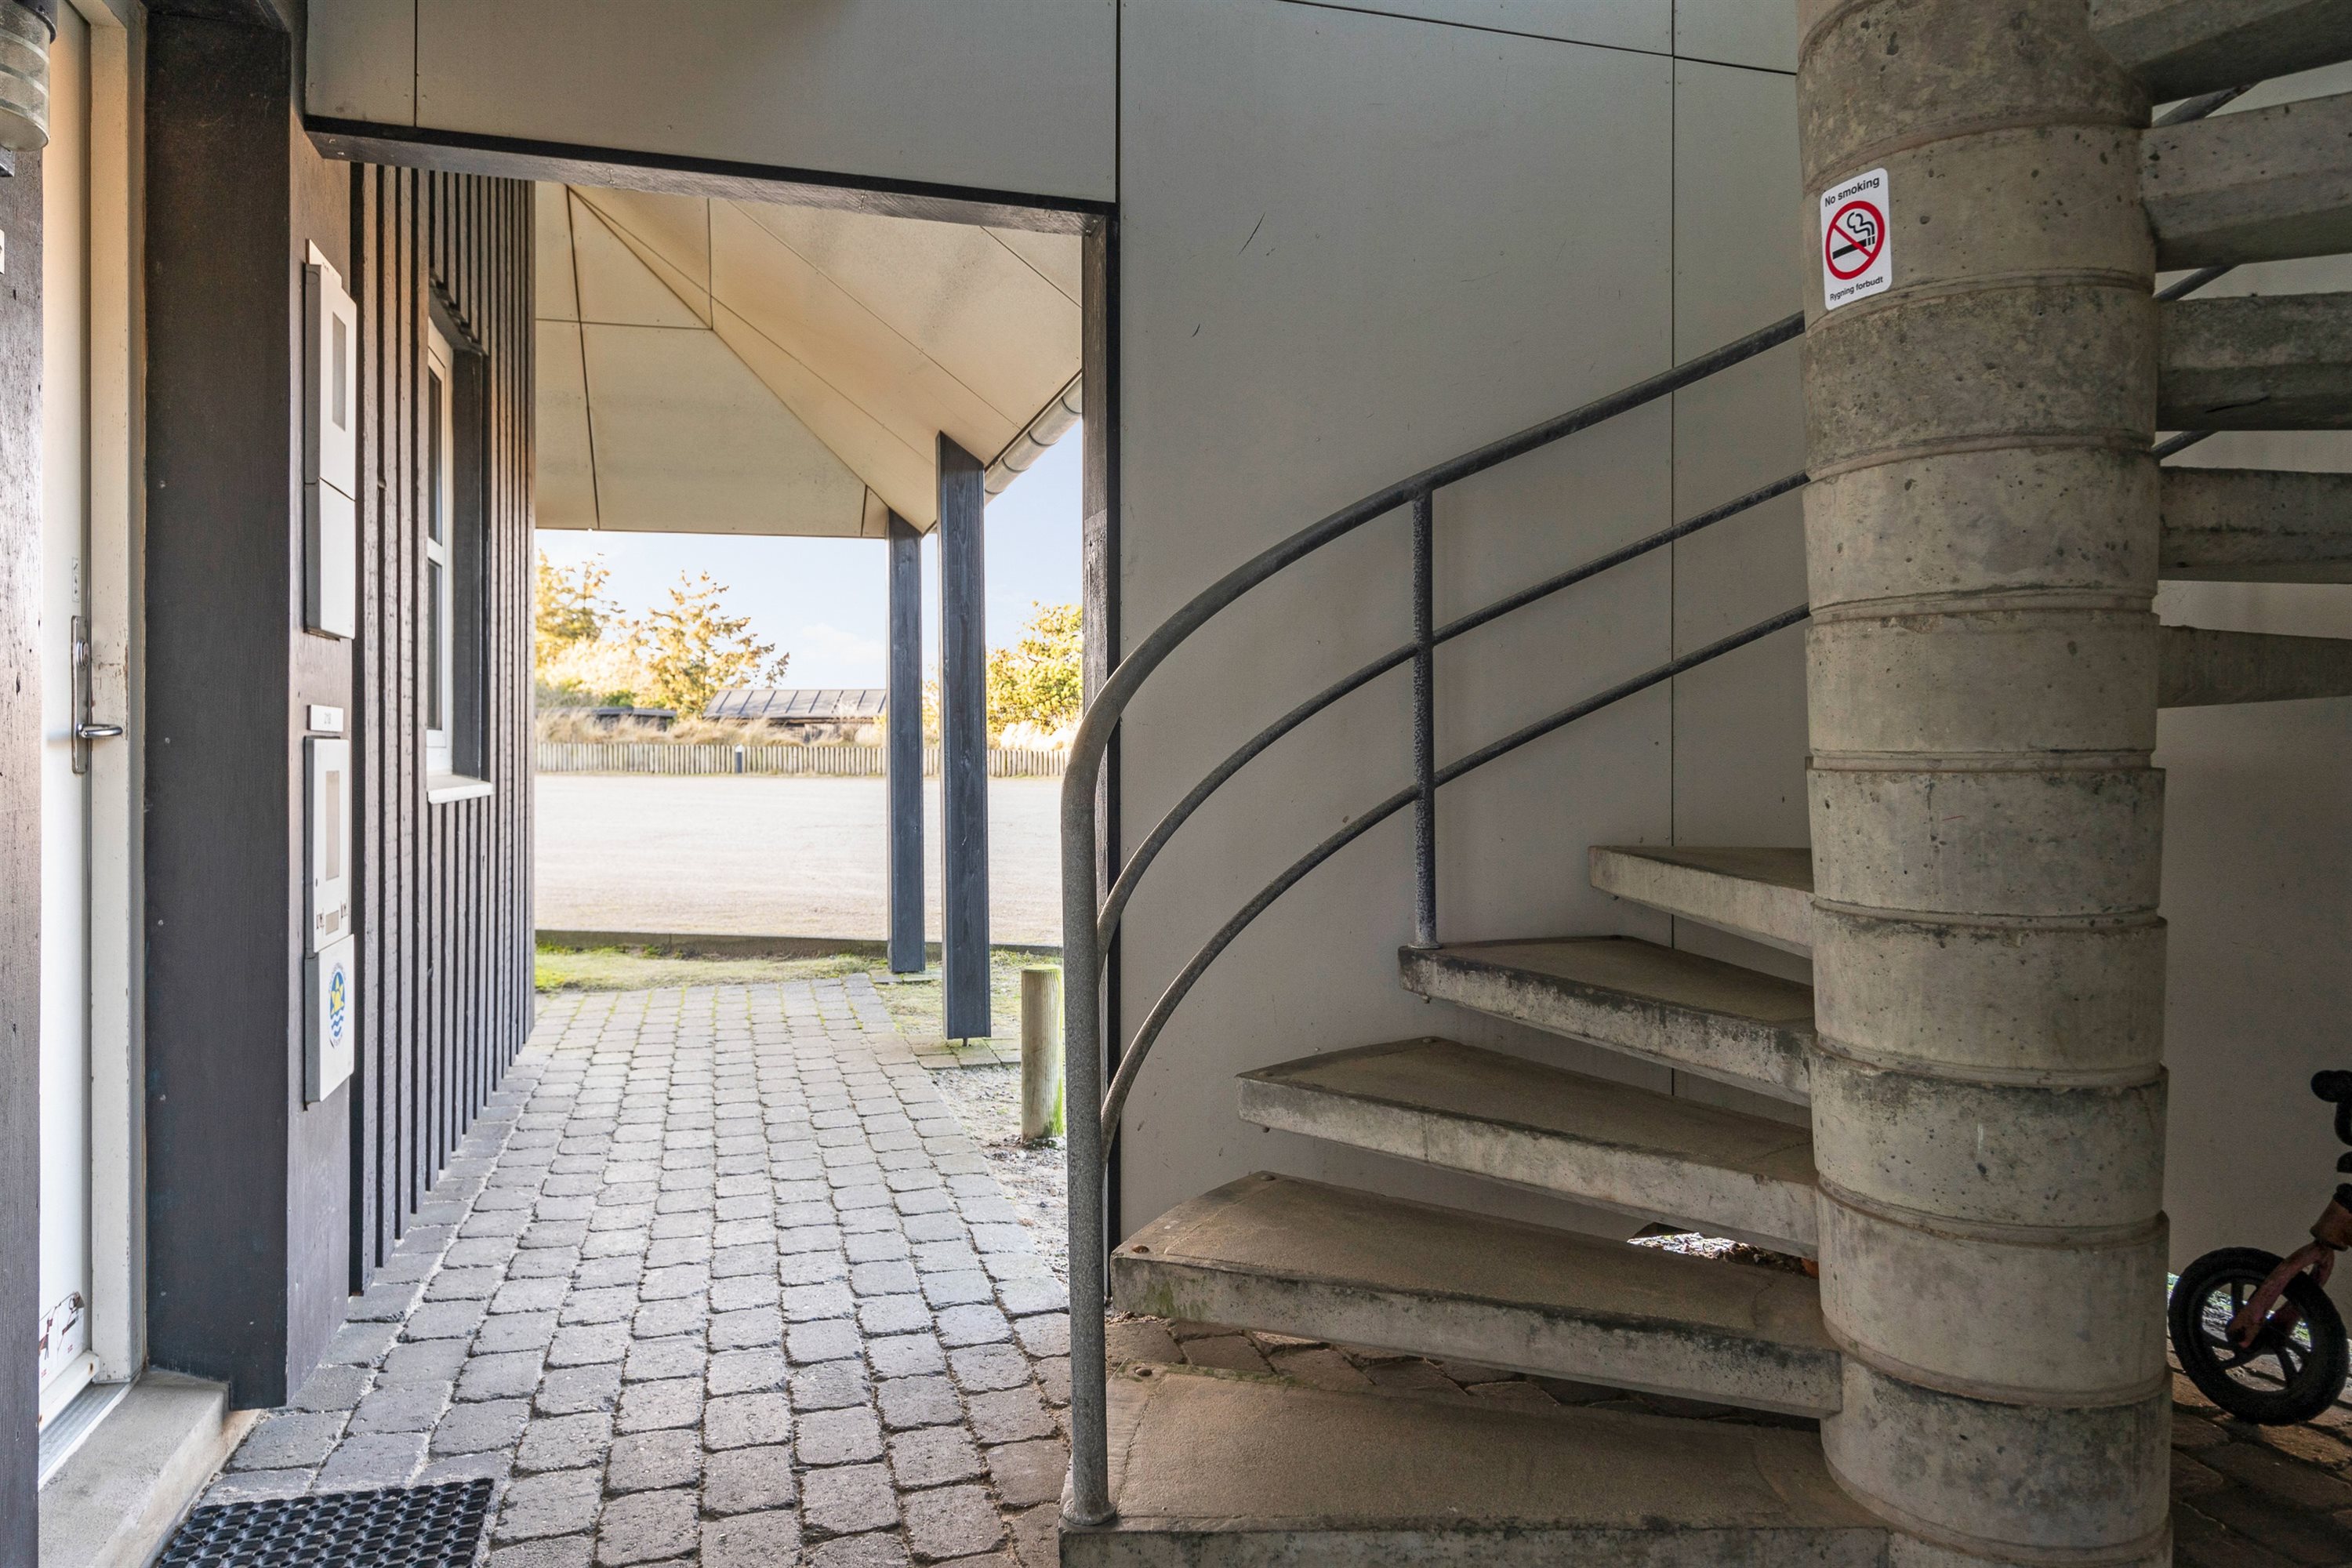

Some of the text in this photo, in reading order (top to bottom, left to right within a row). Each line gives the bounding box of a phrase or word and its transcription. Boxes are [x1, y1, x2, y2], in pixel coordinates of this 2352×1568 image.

[1824, 177, 1880, 207] No smoking
[1829, 276, 1883, 301] Rygning forbudt
